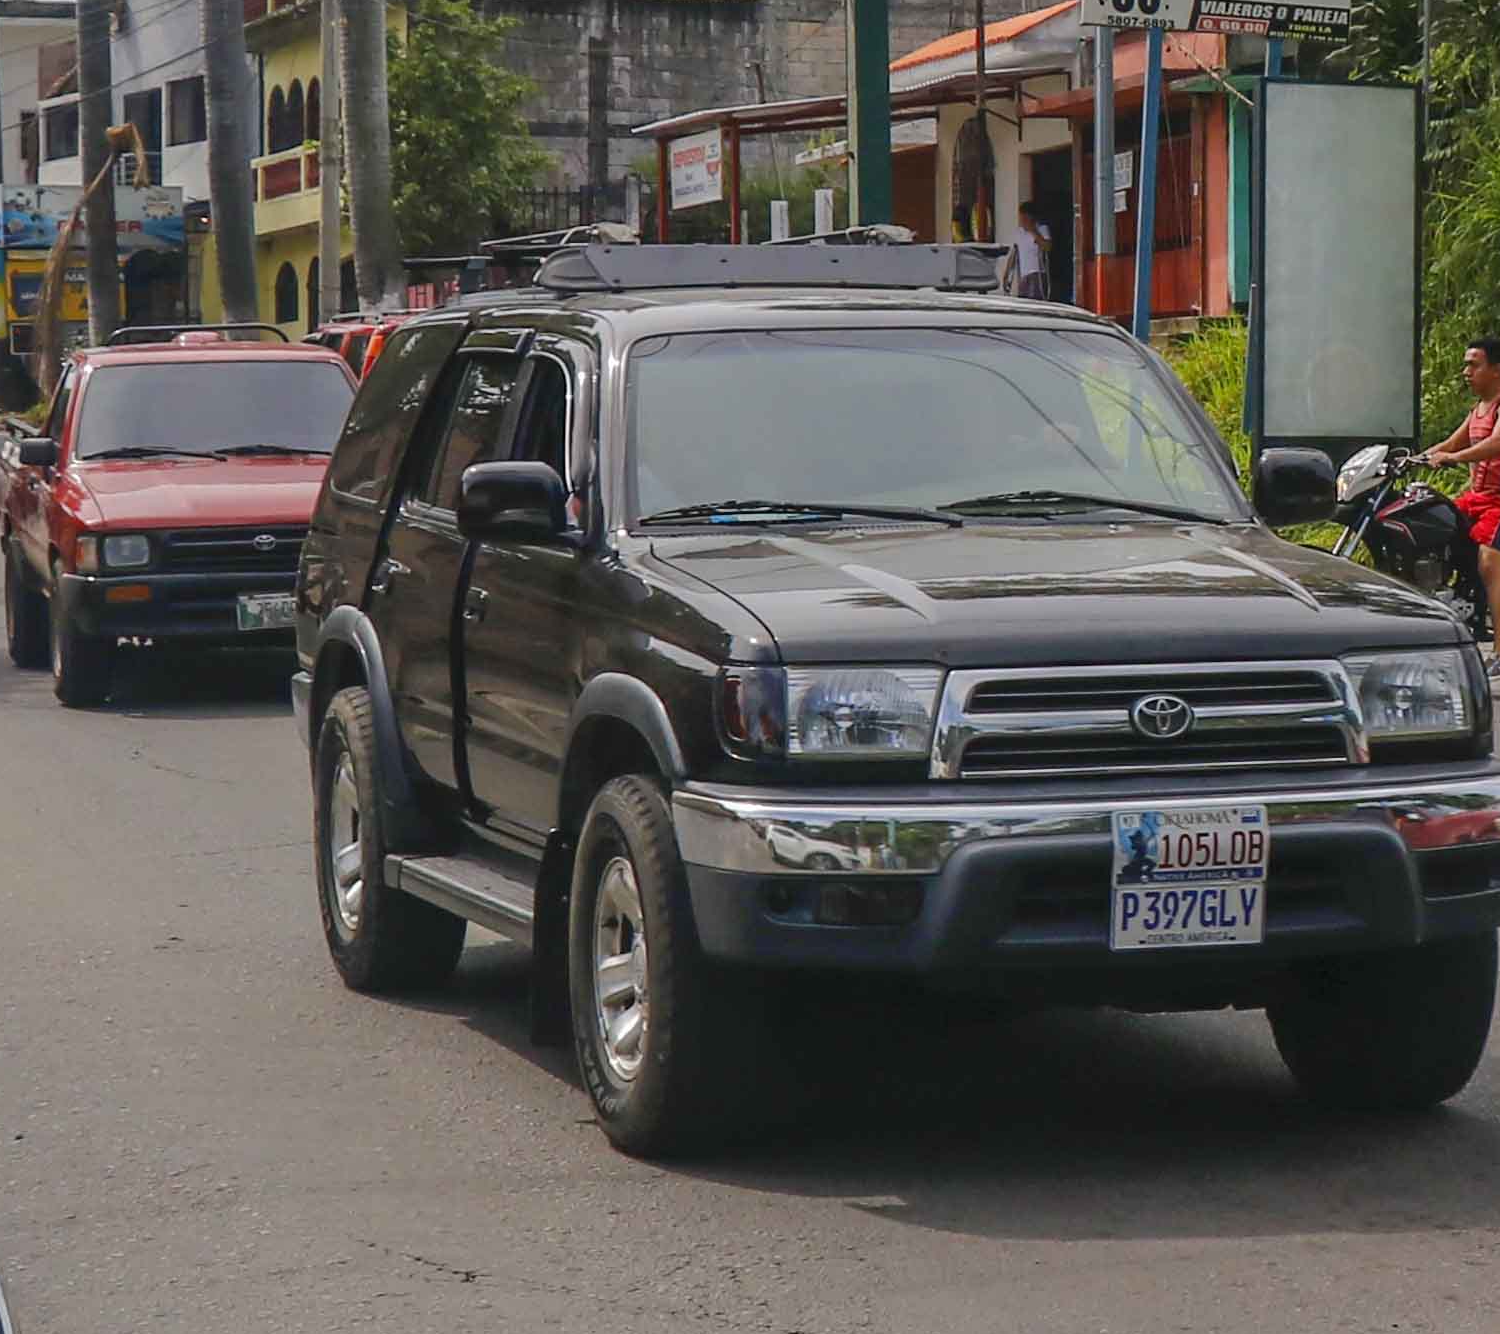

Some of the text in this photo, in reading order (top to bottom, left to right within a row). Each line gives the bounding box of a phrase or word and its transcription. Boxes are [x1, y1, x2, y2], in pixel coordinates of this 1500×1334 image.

[1200, 0, 1348, 25] VIAJEROS O PAREJA
[1122, 888, 1257, 931] P397GLY
